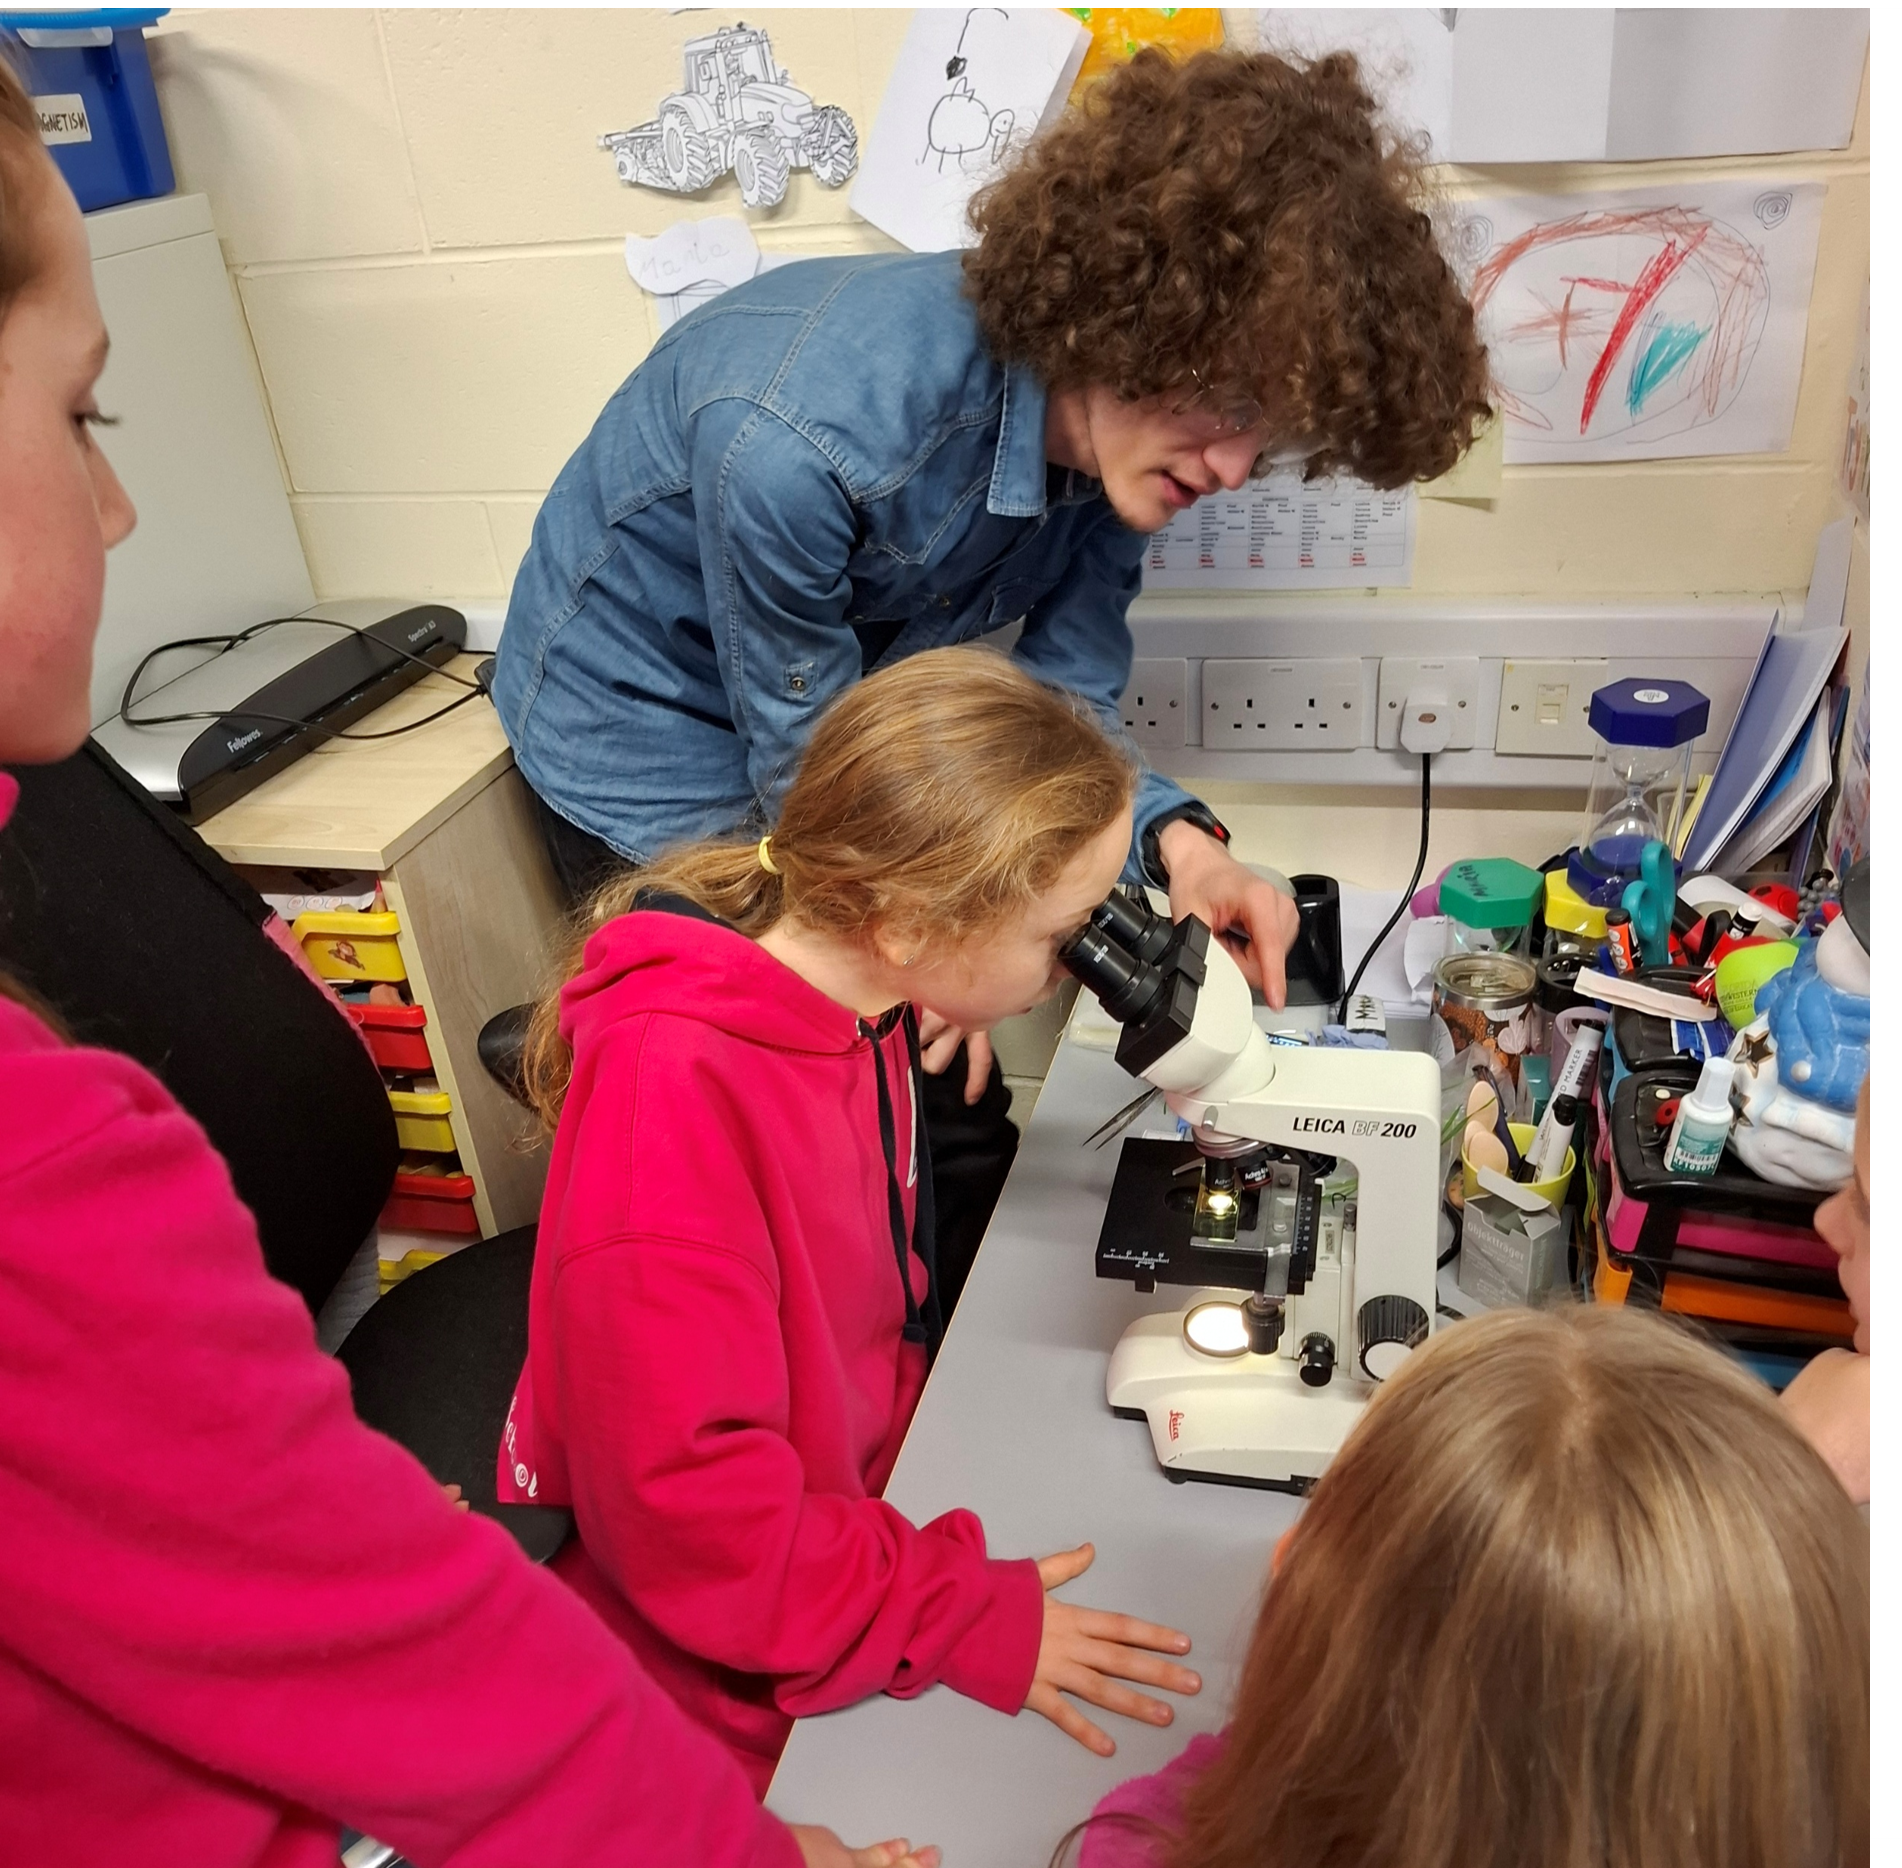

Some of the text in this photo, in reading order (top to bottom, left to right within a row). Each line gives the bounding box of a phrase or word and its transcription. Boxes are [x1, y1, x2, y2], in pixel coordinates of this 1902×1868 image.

[226, 728, 261, 753] Fellowes
[1564, 1048, 1583, 1083] MARKER
[1292, 1116, 1417, 1139] LEICA BF 200
[1168, 1409, 1185, 1442] Leica
